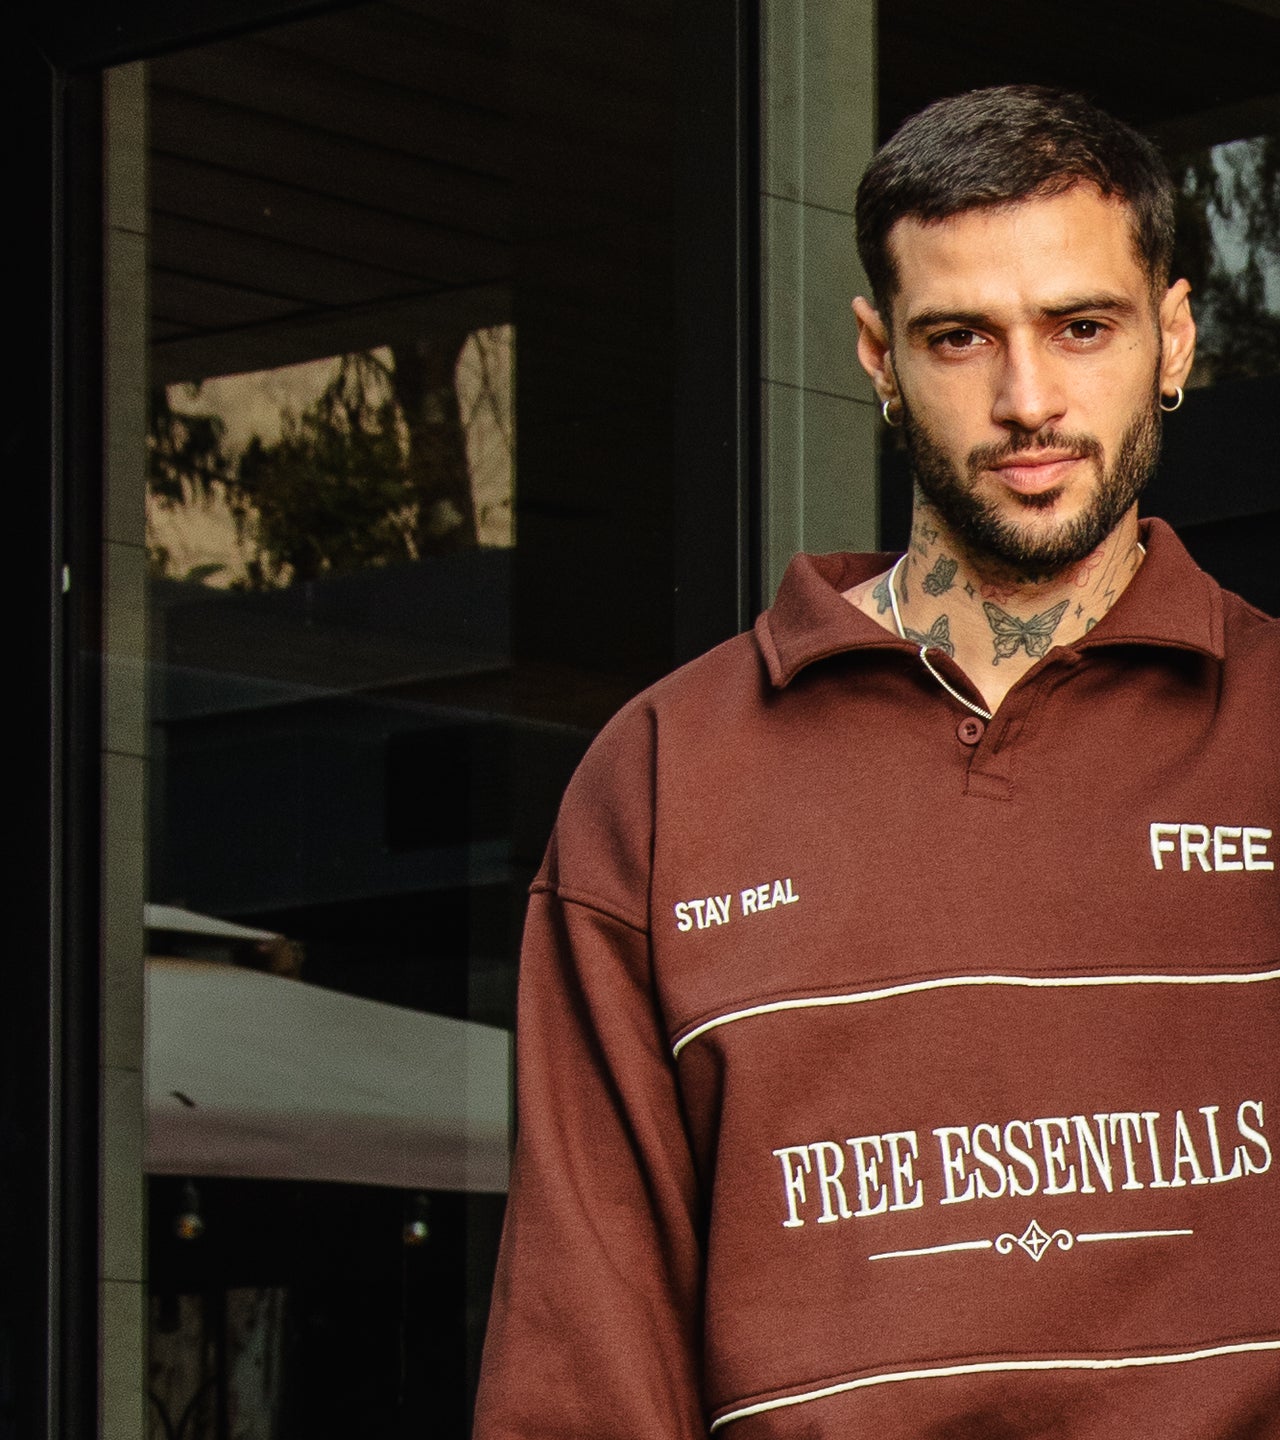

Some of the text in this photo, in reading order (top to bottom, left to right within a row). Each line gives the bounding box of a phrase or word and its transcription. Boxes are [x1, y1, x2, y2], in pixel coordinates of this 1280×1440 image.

[1149, 822, 1274, 873] FREE
[674, 878, 800, 931] STAY REAL
[773, 1100, 1273, 1228] FREE ESSENTIALS
